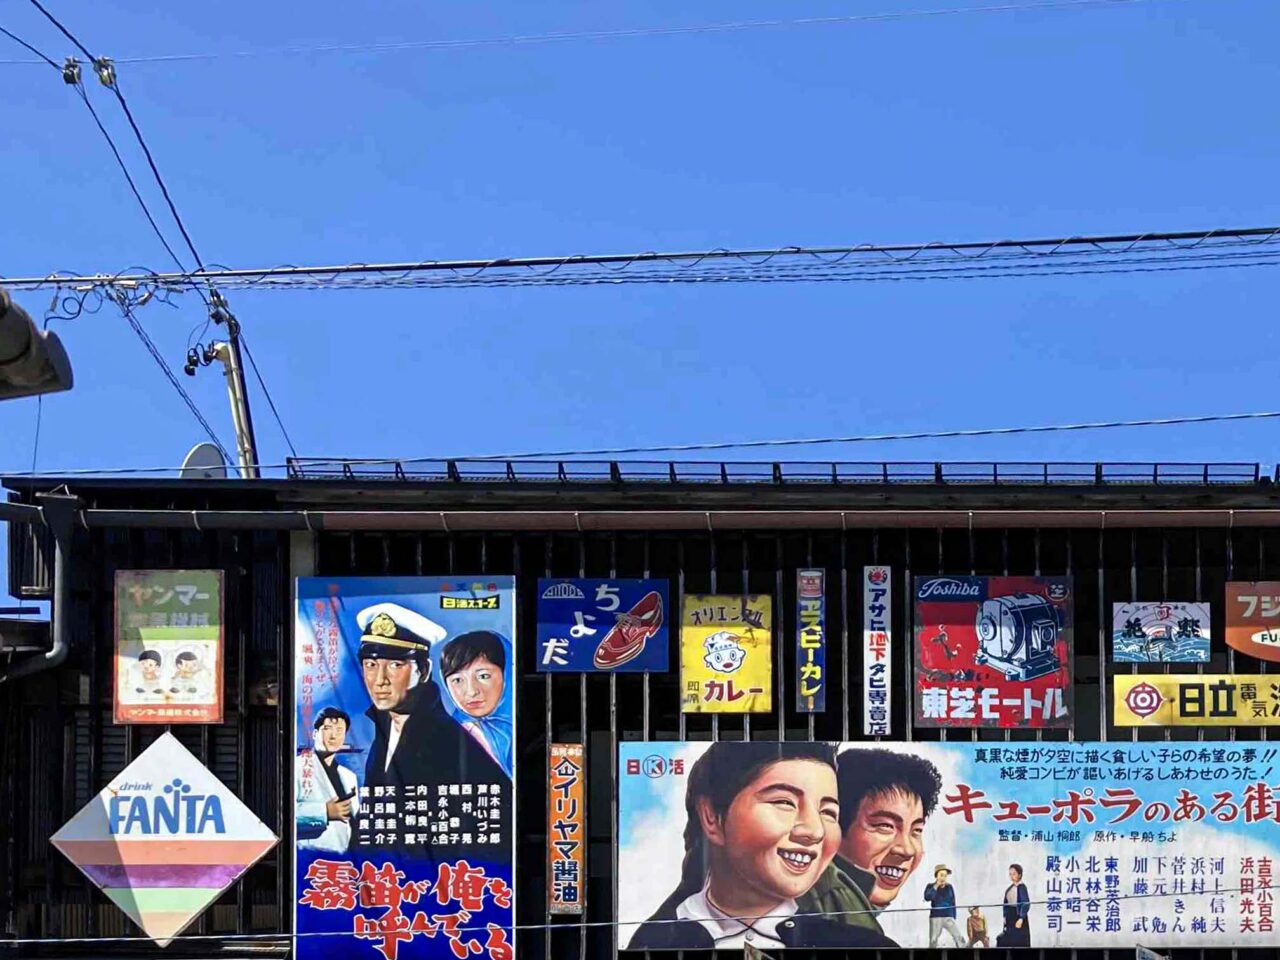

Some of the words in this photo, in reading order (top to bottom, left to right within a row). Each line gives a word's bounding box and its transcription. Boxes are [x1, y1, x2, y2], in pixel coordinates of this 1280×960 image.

[129, 584, 210, 607] ヤンマー
[918, 578, 980, 598] Toshiba
[704, 680, 763, 702] カレー
[922, 687, 1069, 720] 東芝モートル
[108, 794, 226, 835] FANTA
[119, 781, 152, 791] drink
[298, 858, 514, 911] 霧笛が俺を
[1065, 856, 1081, 925] 小沢昭一
[1085, 856, 1102, 932] 北林谷栄
[1104, 856, 1121, 932] 東野英治郎
[1132, 856, 1149, 933] 加藤武
[1170, 856, 1187, 933] 菅井きん
[1190, 856, 1207, 933] 浜村純
[1240, 856, 1255, 933] 浜田光夫
[1257, 856, 1274, 933] 吉永小百合
